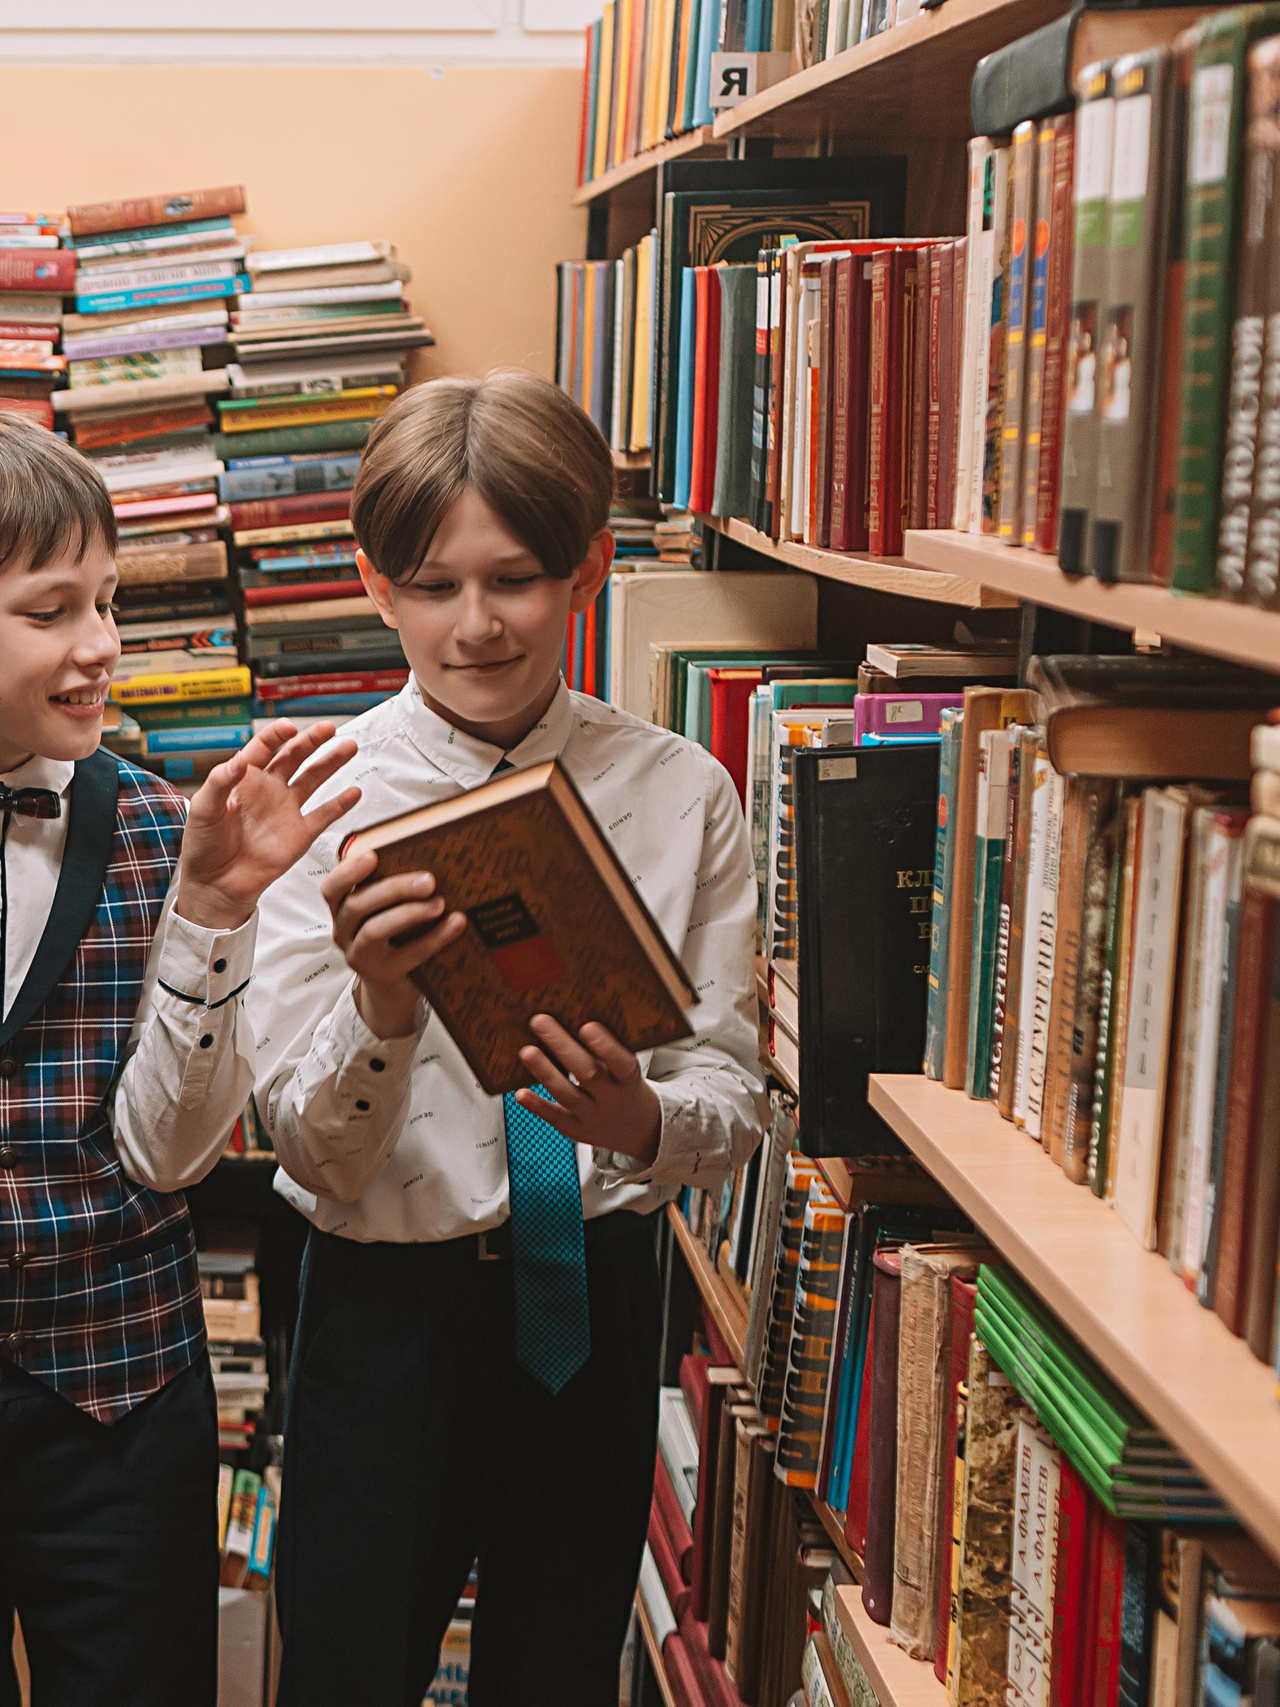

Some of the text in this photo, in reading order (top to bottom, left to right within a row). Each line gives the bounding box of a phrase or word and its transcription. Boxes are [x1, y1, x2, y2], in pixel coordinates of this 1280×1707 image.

[719, 66, 748, 97] Я
[976, 367, 984, 416] КАЗАКИ
[660, 747, 684, 766] GENIUS
[593, 762, 615, 782] GENIUS
[608, 811, 633, 831] GENIUS
[679, 796, 702, 820] GENIUS
[896, 869, 934, 889] КЛ
[909, 896, 933, 914] П
[304, 962, 330, 984] GENIUS
[995, 903, 1011, 1037] ТУРГЕНЕВ
[1028, 911, 1055, 1117] И. С. ТУРГЕНЕВ
[990, 1045, 1004, 1094] И.С.
[402, 1173, 425, 1190] GENIUS
[1018, 1444, 1032, 1568] А. ФАДЕЕВ
[1034, 1464, 1049, 1588] А. ФАДЕЕВ
[1026, 1666, 1037, 1698] 2
